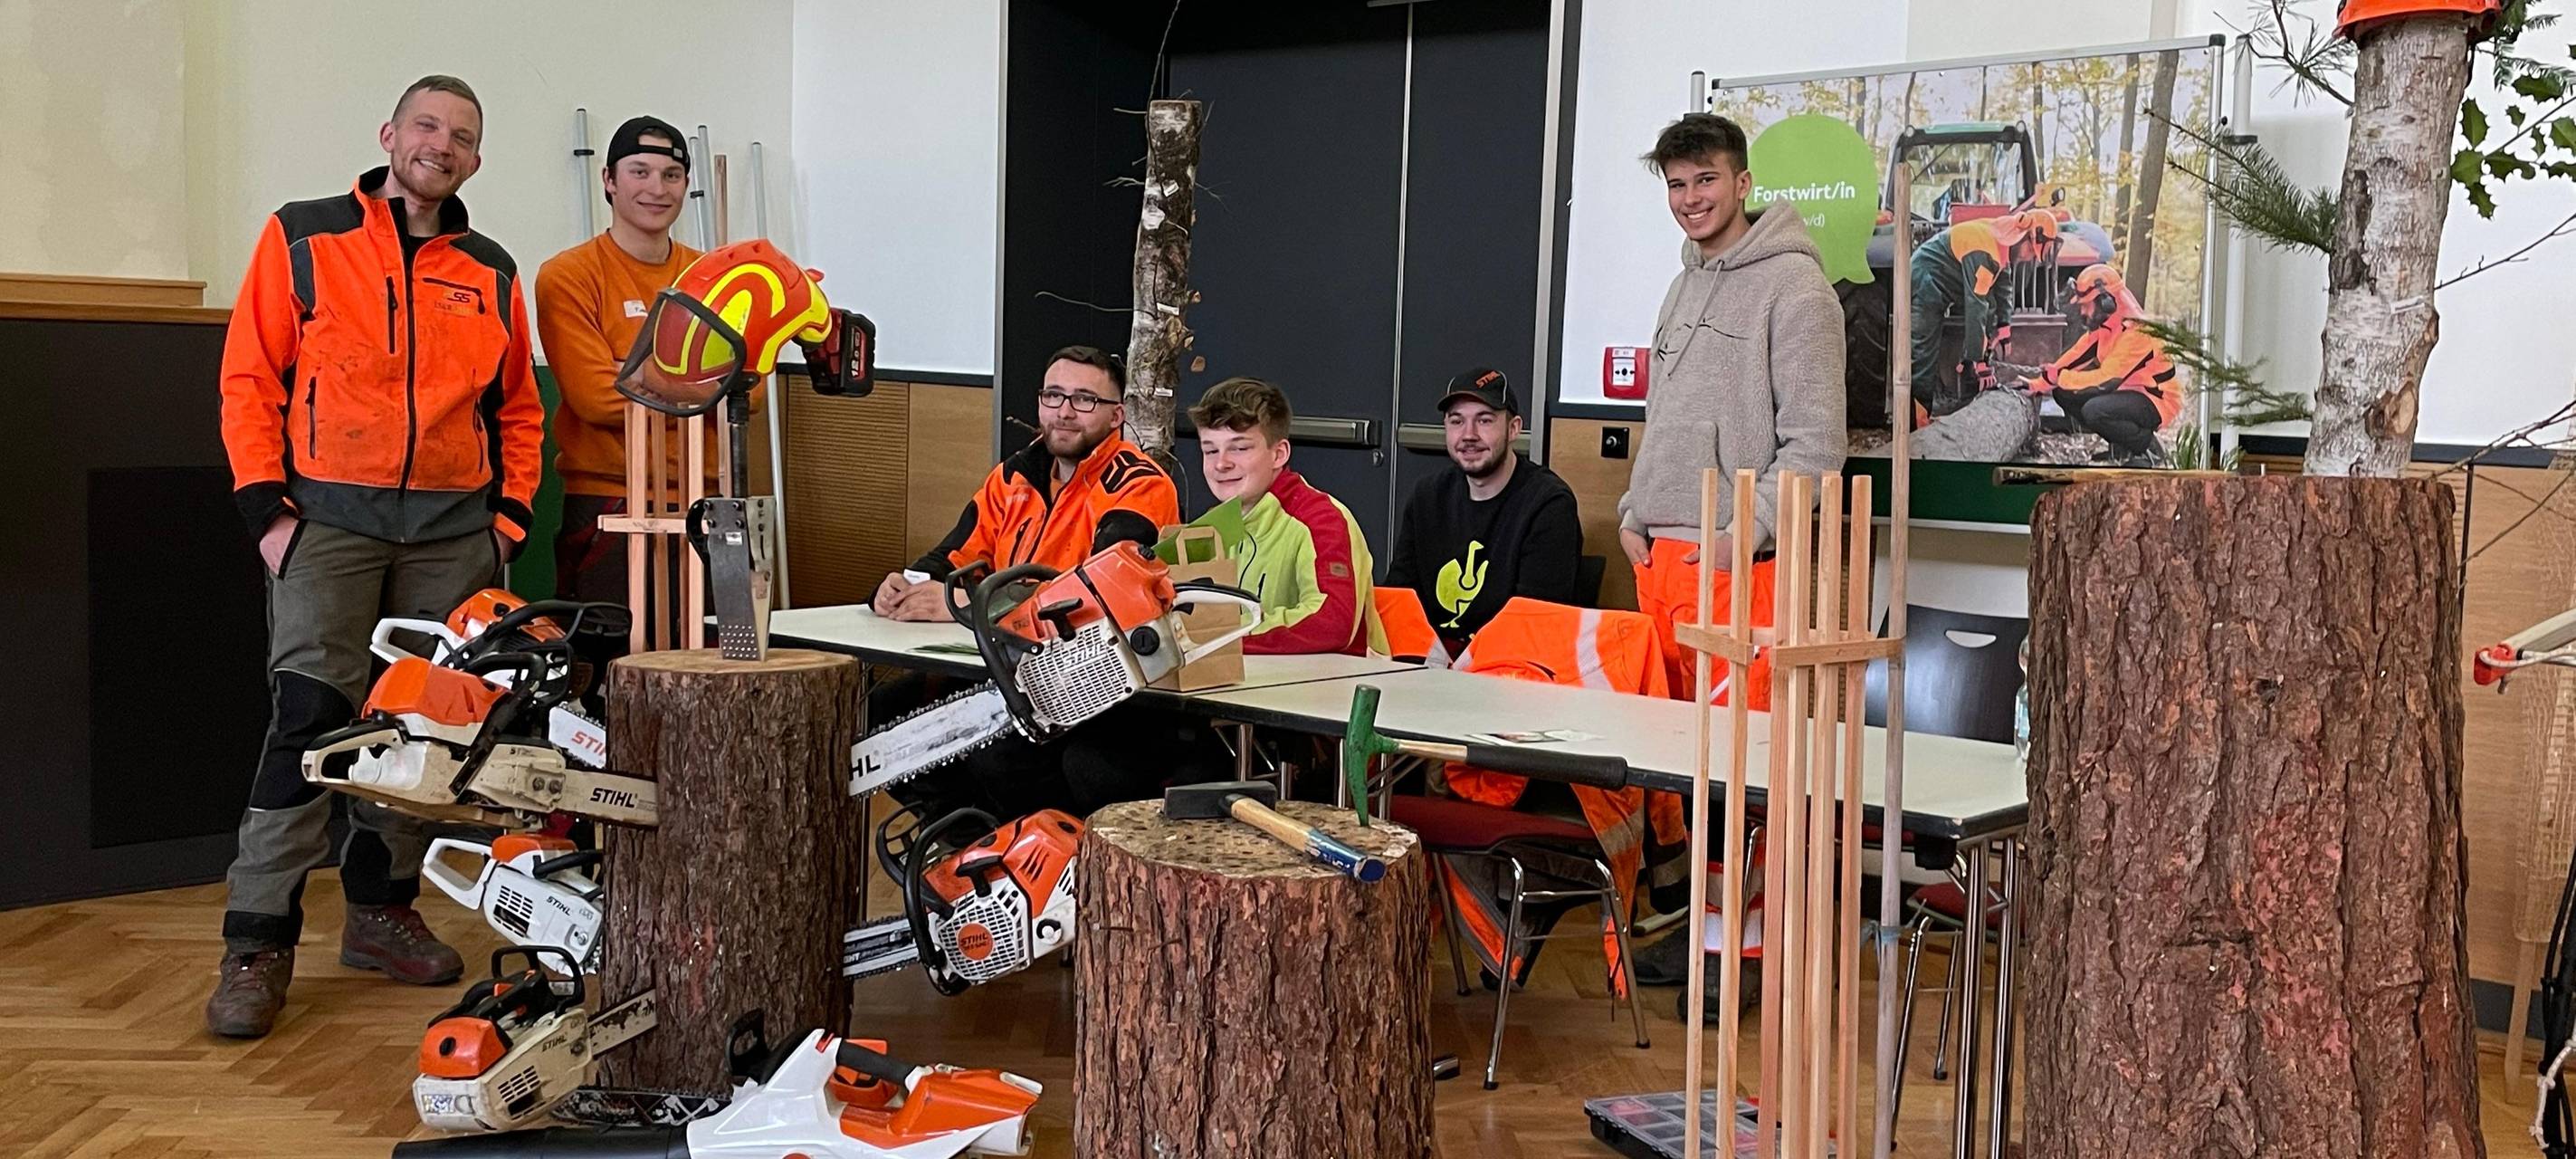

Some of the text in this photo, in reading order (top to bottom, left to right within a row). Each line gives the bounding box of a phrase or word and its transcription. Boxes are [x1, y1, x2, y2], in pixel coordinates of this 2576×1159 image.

[1754, 181, 1856, 202] Forstwirt/in
[1063, 642, 1107, 666] STIHL
[589, 787, 635, 809] STIHL
[545, 896, 572, 917] STIHL
[960, 933, 988, 947] STIHL
[541, 1034, 568, 1052] STIHL
